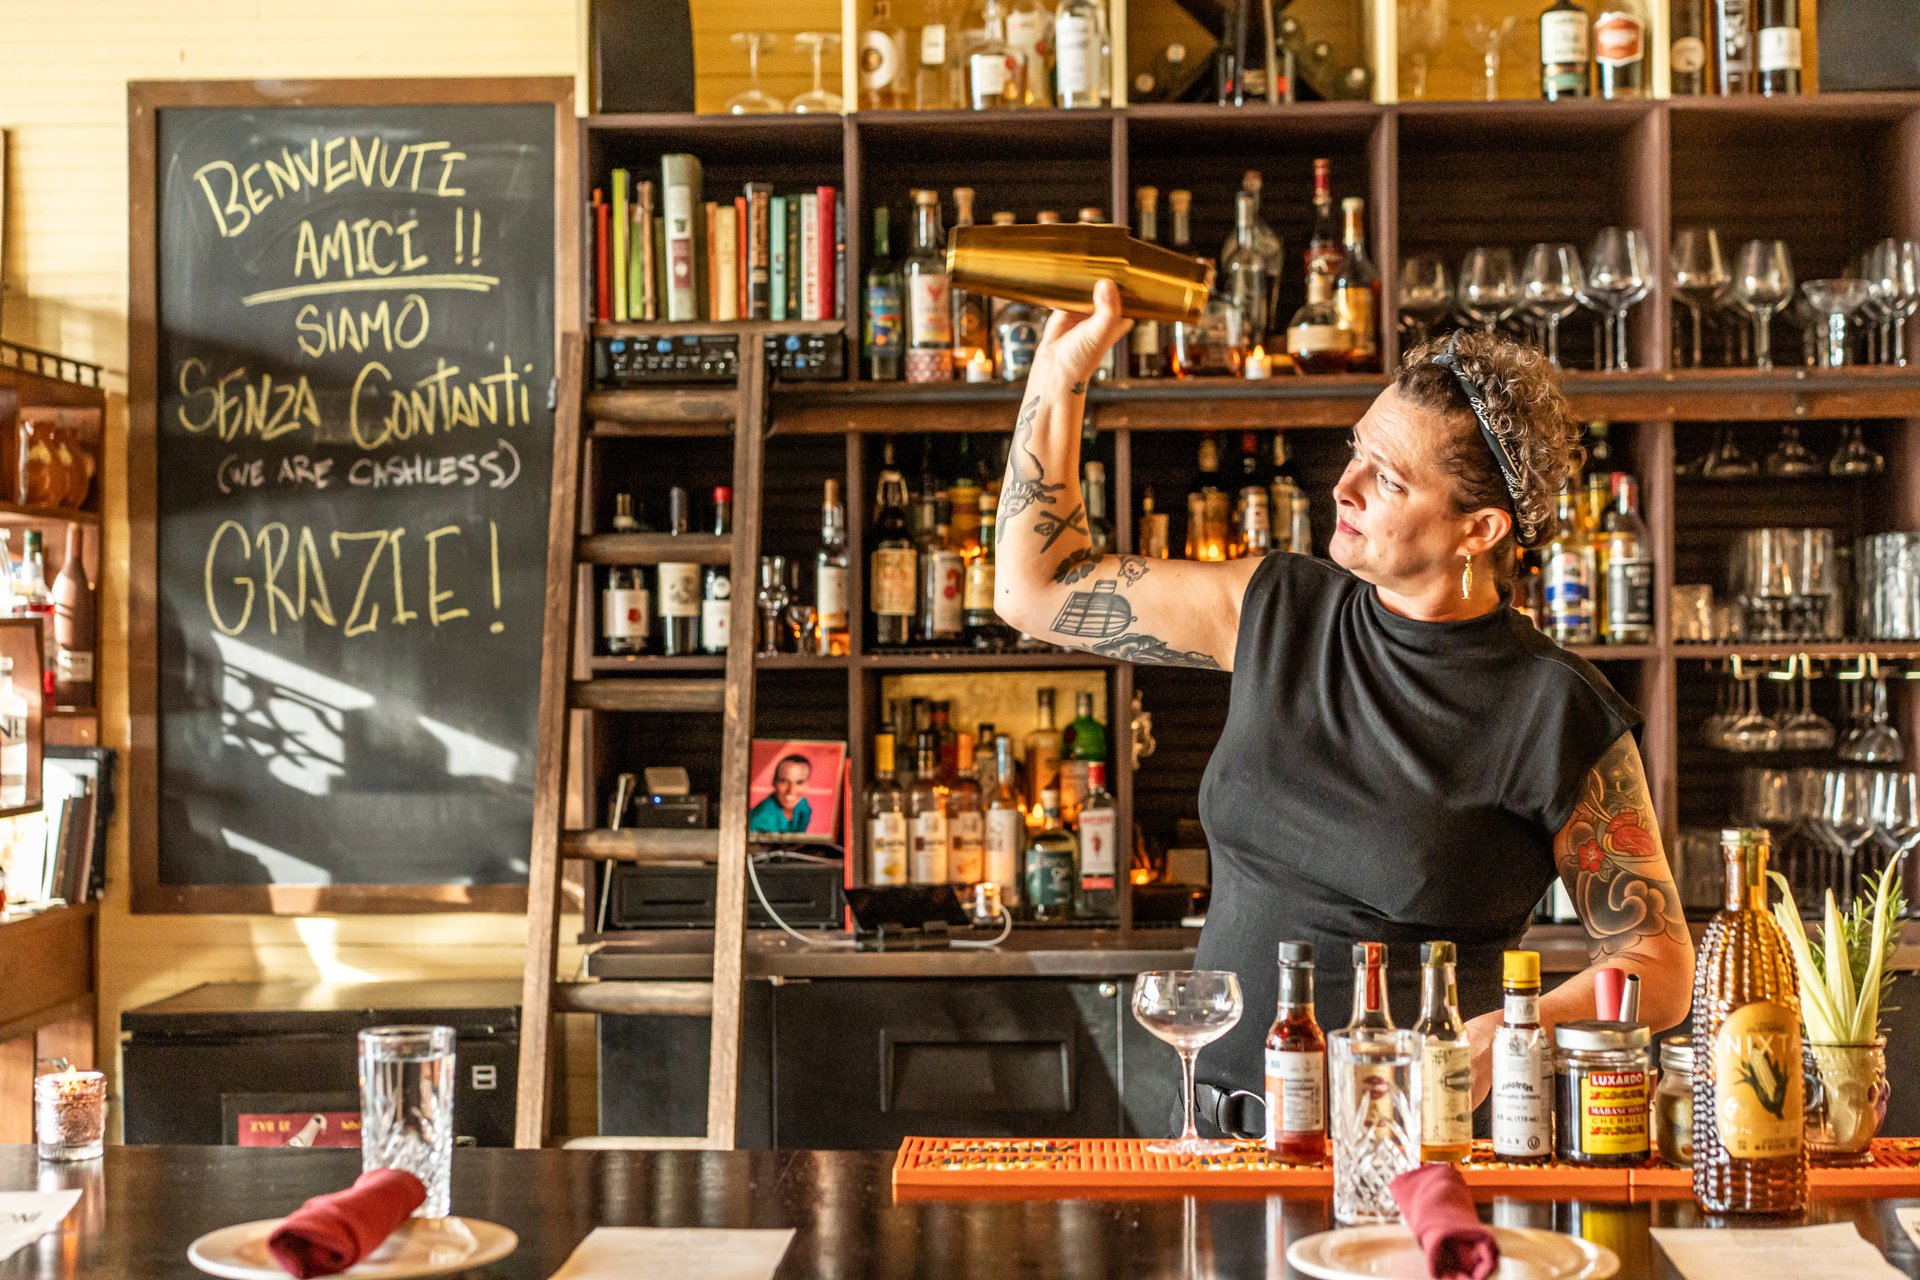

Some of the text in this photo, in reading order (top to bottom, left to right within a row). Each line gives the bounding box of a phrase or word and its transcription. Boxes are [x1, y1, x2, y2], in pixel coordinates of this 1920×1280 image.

[193, 136, 467, 237] BENVENUTI
[294, 219, 428, 279] AMICI
[295, 293, 429, 358] SIAMO
[178, 356, 321, 443] SENZA
[277, 453, 334, 489] ARE
[1591, 1073, 1644, 1086] LUXARDO
[1591, 1104, 1645, 1116] MARASCHINO
